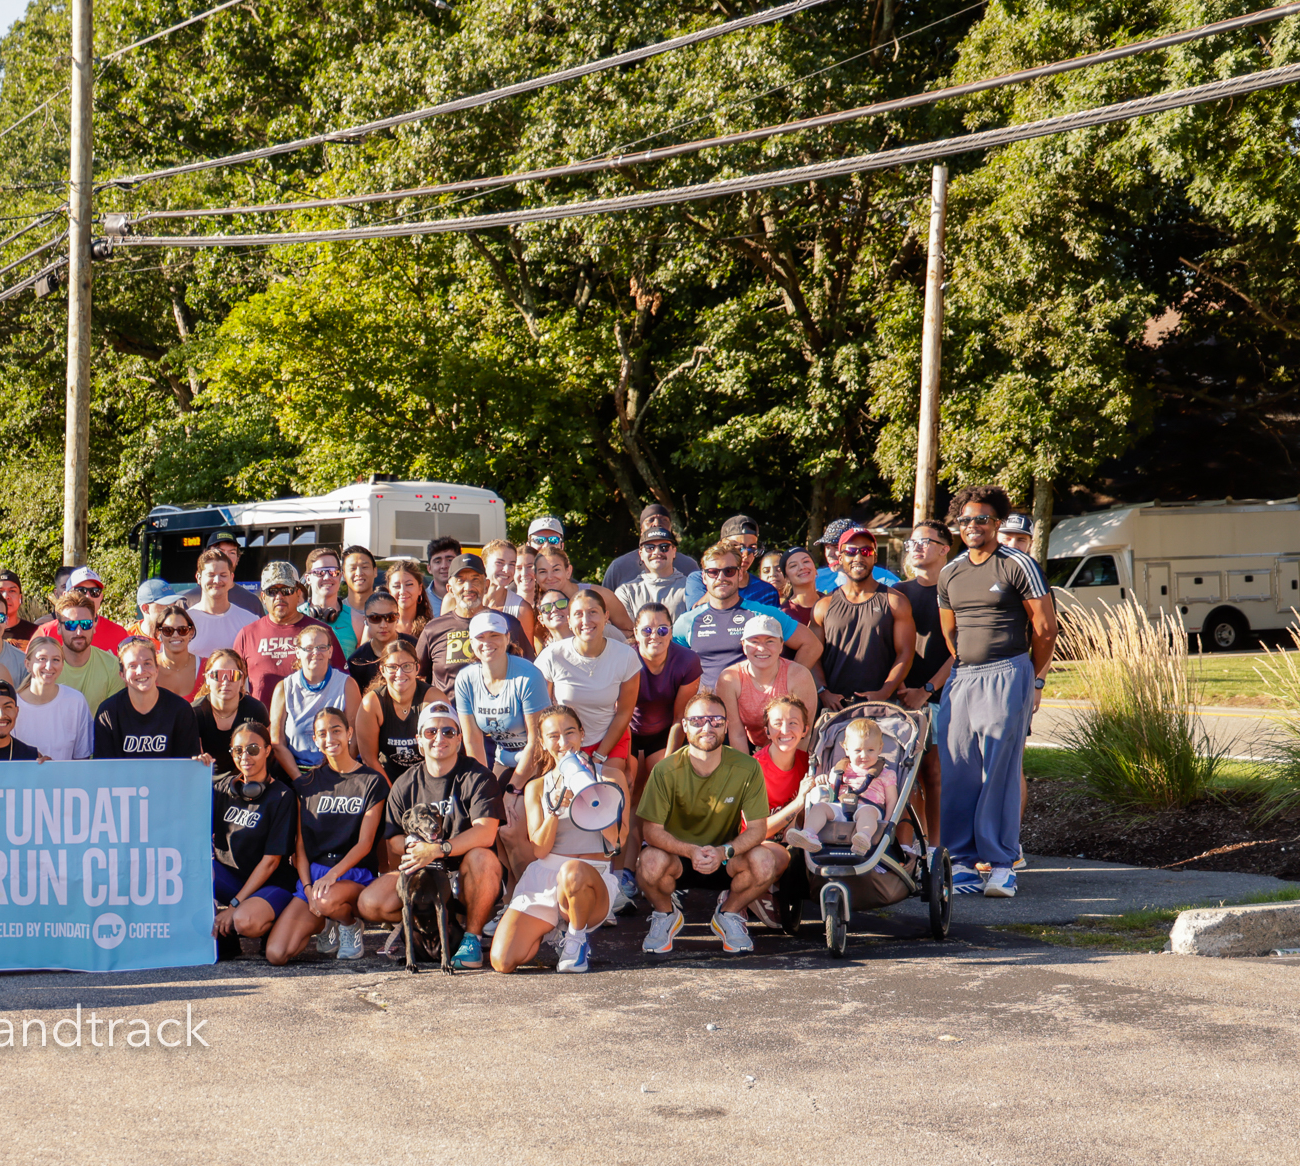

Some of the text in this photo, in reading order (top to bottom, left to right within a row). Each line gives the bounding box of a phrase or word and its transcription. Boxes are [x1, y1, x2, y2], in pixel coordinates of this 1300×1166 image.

[425, 502, 450, 513] 2407
[477, 706, 511, 715] RHODE
[123, 735, 167, 753] DRC
[316, 796, 363, 814] DRC
[223, 806, 261, 828] DRC
[82, 847, 184, 907] CLUB
[26, 922, 41, 938] BY
[44, 922, 90, 940] FUNDATi
[128, 922, 171, 939] COFFEE
